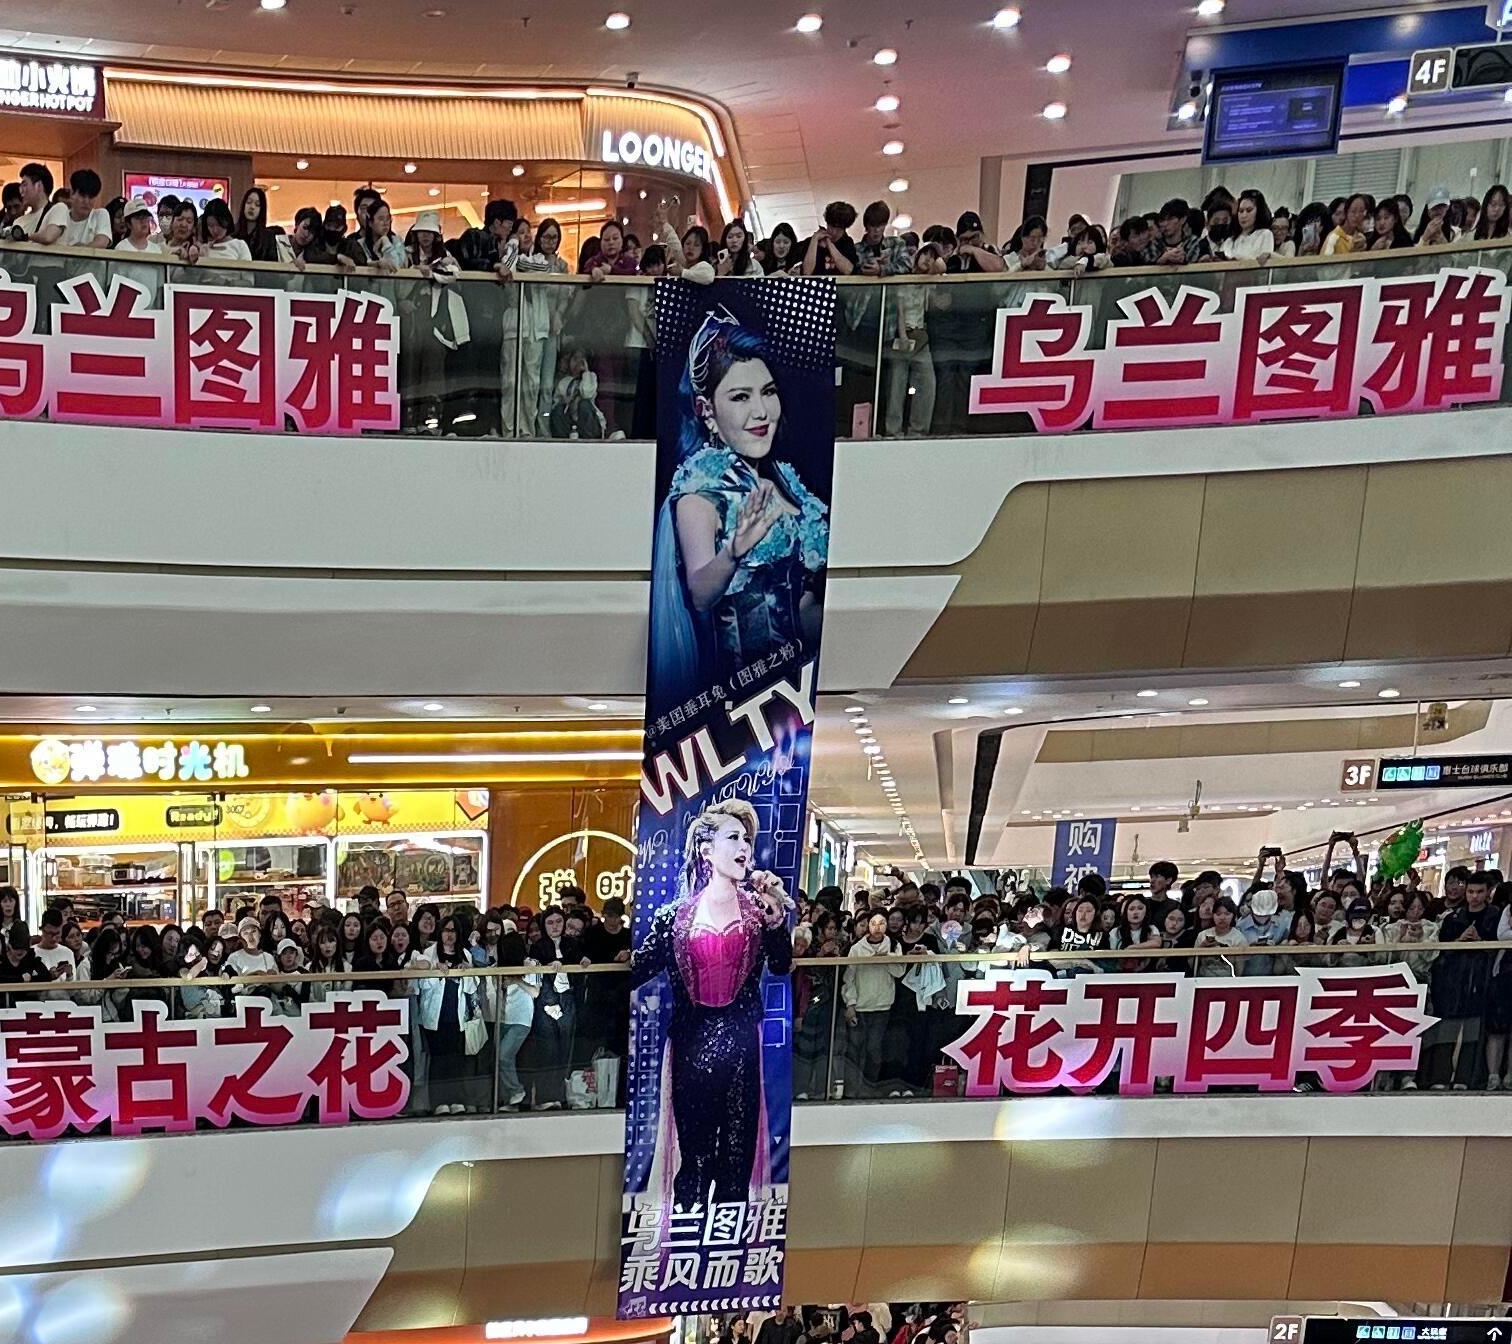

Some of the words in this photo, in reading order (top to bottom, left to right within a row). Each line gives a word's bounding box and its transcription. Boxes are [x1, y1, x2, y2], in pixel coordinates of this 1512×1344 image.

[1415, 59, 1447, 84] 4F
[38, 93, 67, 111] HOT
[68, 96, 95, 112] POT
[978, 274, 1502, 428] 乌兰图雅
[640, 660, 816, 816] WLTY
[1345, 764, 1372, 786] 3F
[960, 973, 1420, 1086] 花开四季
[0, 1000, 404, 1130] 蒙古之花
[621, 1196, 787, 1251] 乌兰图雅
[619, 1245, 784, 1293] 乘风而歌
[1273, 1323, 1299, 1341] 2F
